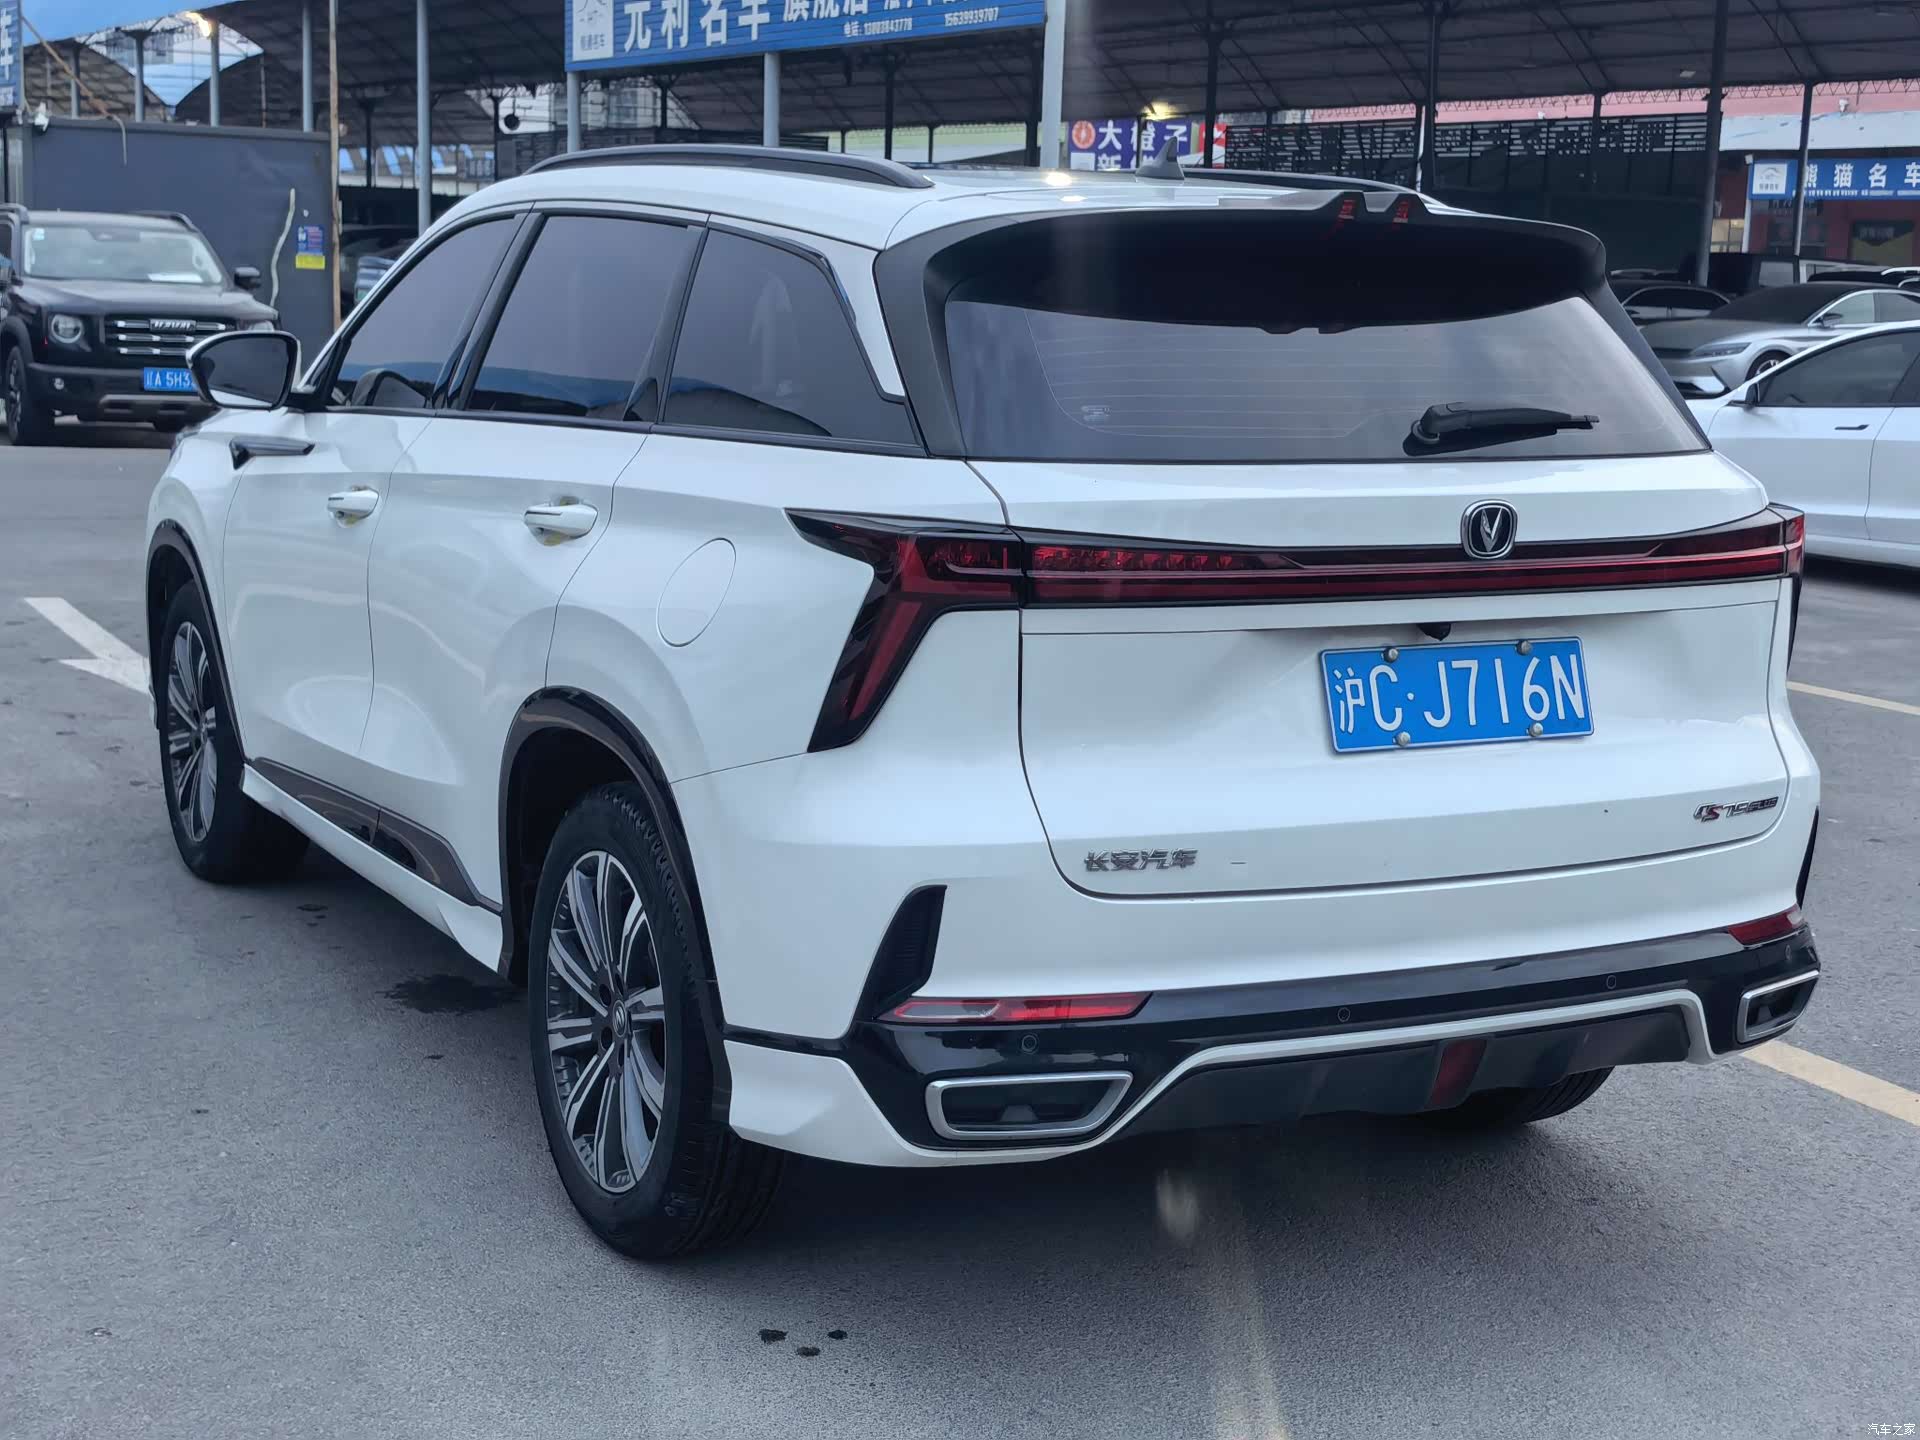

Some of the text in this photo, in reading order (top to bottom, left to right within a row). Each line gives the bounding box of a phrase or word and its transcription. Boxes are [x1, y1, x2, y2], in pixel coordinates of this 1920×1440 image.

[1332, 653, 1586, 734] 沪C·J716N
[1084, 847, 1199, 872] 长安汽车
